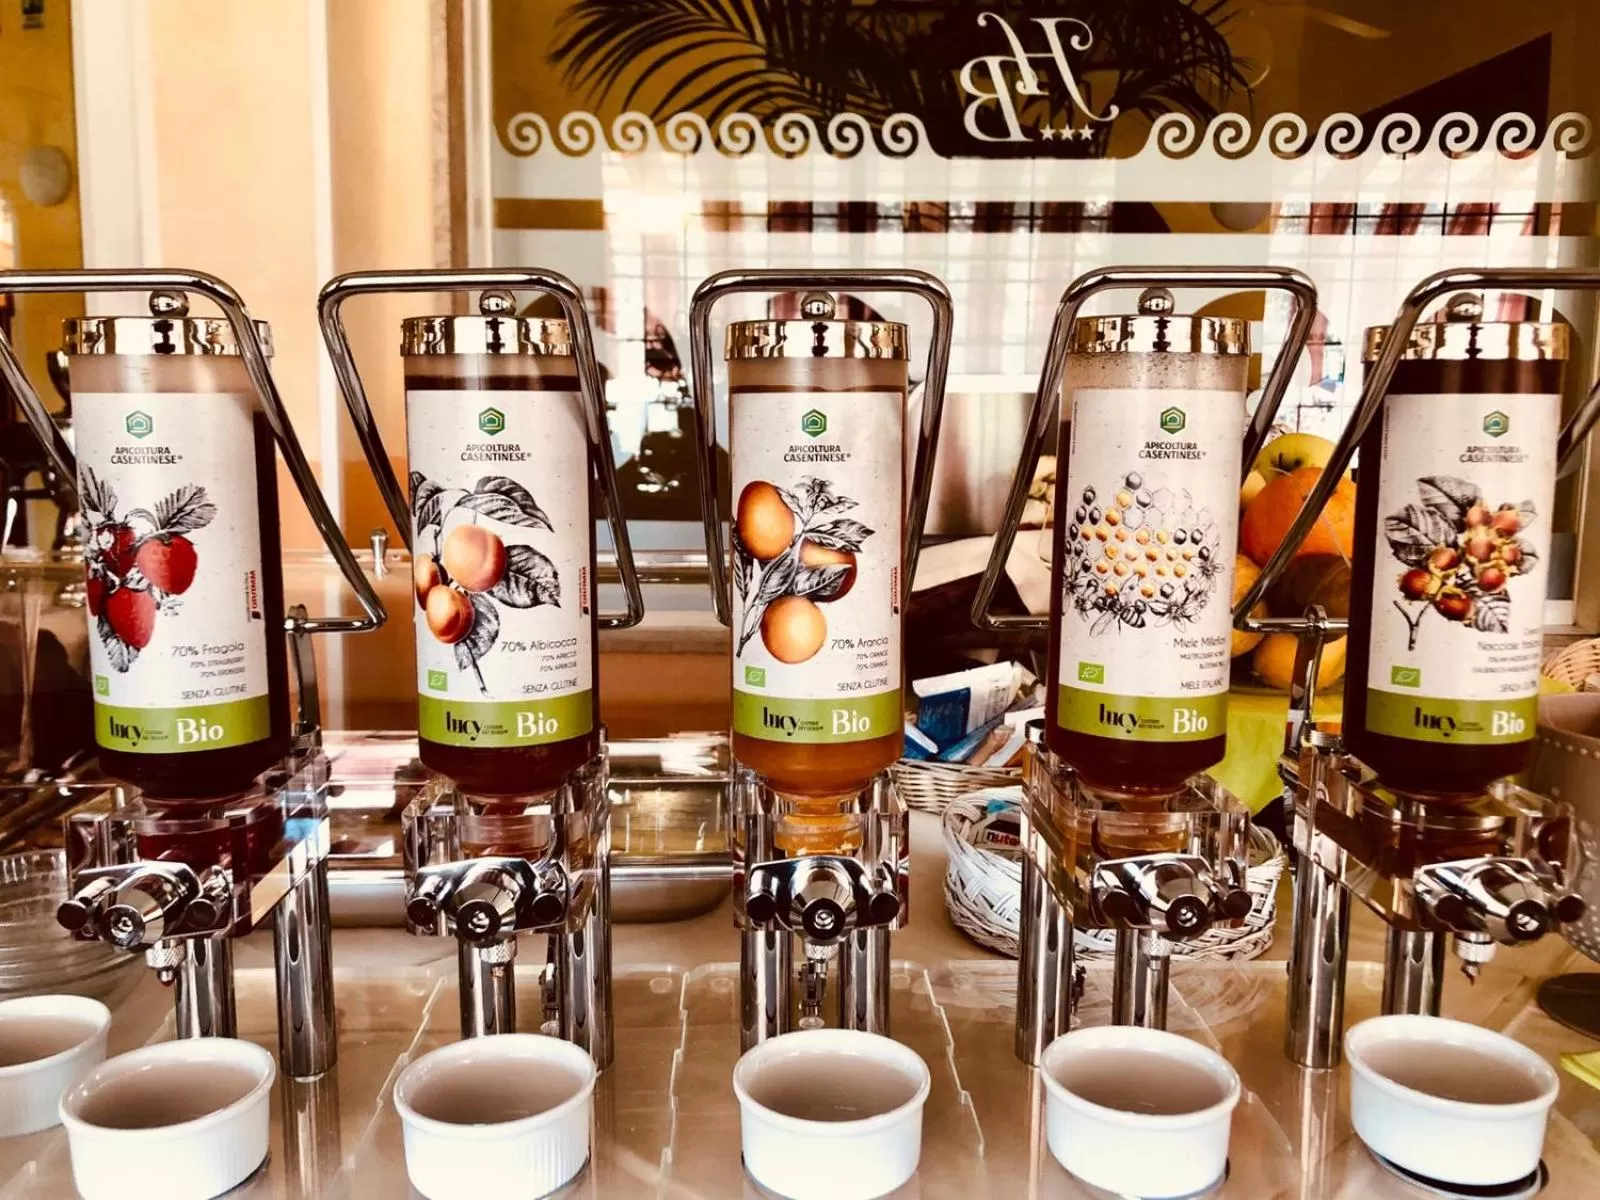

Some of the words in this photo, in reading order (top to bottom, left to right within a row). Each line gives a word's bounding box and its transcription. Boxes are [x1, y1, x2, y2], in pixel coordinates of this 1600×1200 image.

[114, 446, 171, 455] APICOLTURA
[466, 444, 521, 452] APICOLTURA
[789, 445, 841, 453] APICOLTURA
[1144, 442, 1197, 450] APICOLTURA
[172, 645, 199, 657] 70%
[202, 642, 245, 655] Fragola
[500, 641, 527, 652] 70%
[530, 637, 577, 651] Albicocca
[831, 639, 855, 650] 70%
[857, 637, 889, 648] Arancia
[181, 688, 211, 699] SENZA
[213, 683, 247, 697] GLUTINE
[521, 683, 549, 694] SENZA
[550, 677, 578, 691] GLUTINE
[837, 681, 862, 691] SENZA
[863, 677, 889, 689] GLUTINE
[446, 710, 484, 741] lucy
[516, 711, 559, 738] Bio
[762, 706, 800, 736] lucy
[831, 709, 871, 736] Bio
[1099, 703, 1141, 734] lucy
[1172, 707, 1208, 734] Bio
[1414, 706, 1457, 737] lucy
[1491, 710, 1526, 736] Bio
[109, 715, 144, 746] lucy
[176, 717, 224, 744] Bio
